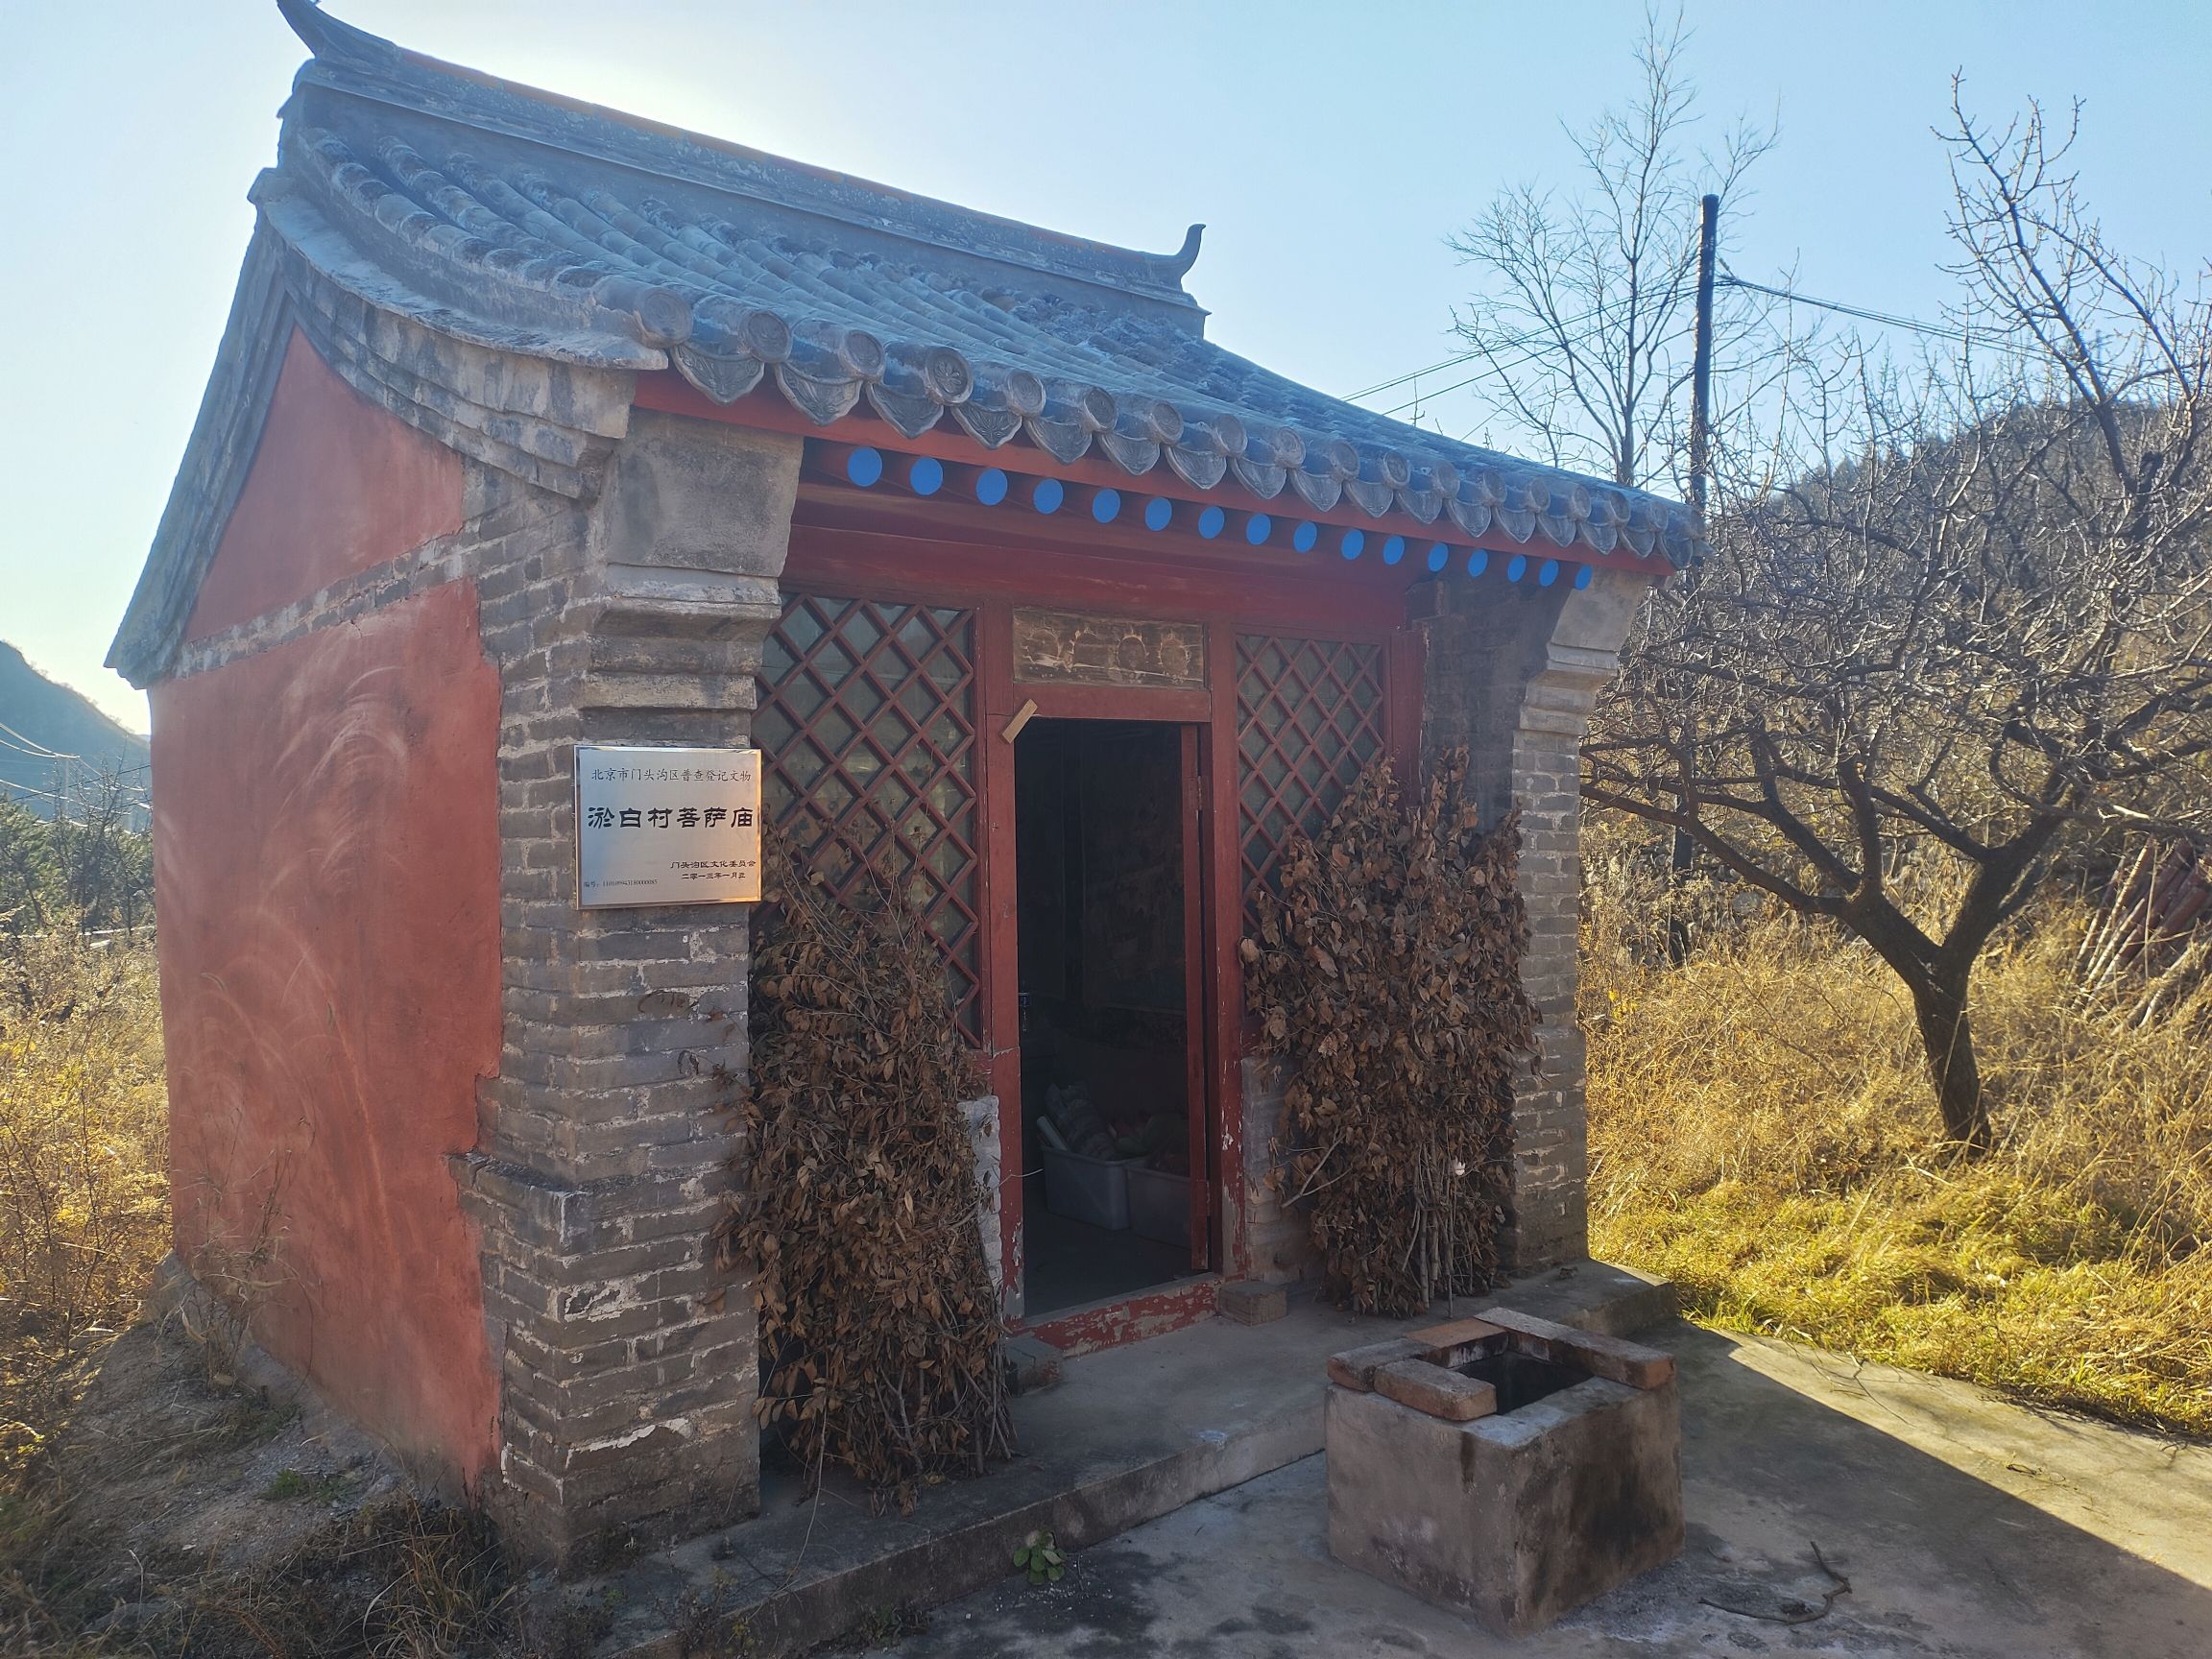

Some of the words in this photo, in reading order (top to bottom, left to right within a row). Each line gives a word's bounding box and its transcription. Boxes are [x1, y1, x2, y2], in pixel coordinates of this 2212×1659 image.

[591, 768, 752, 782] 北京市门头沟区普查登记文物
[588, 806, 754, 829] 淤白村菩萨庙
[670, 859, 757, 869] 门头沟区文化委员会
